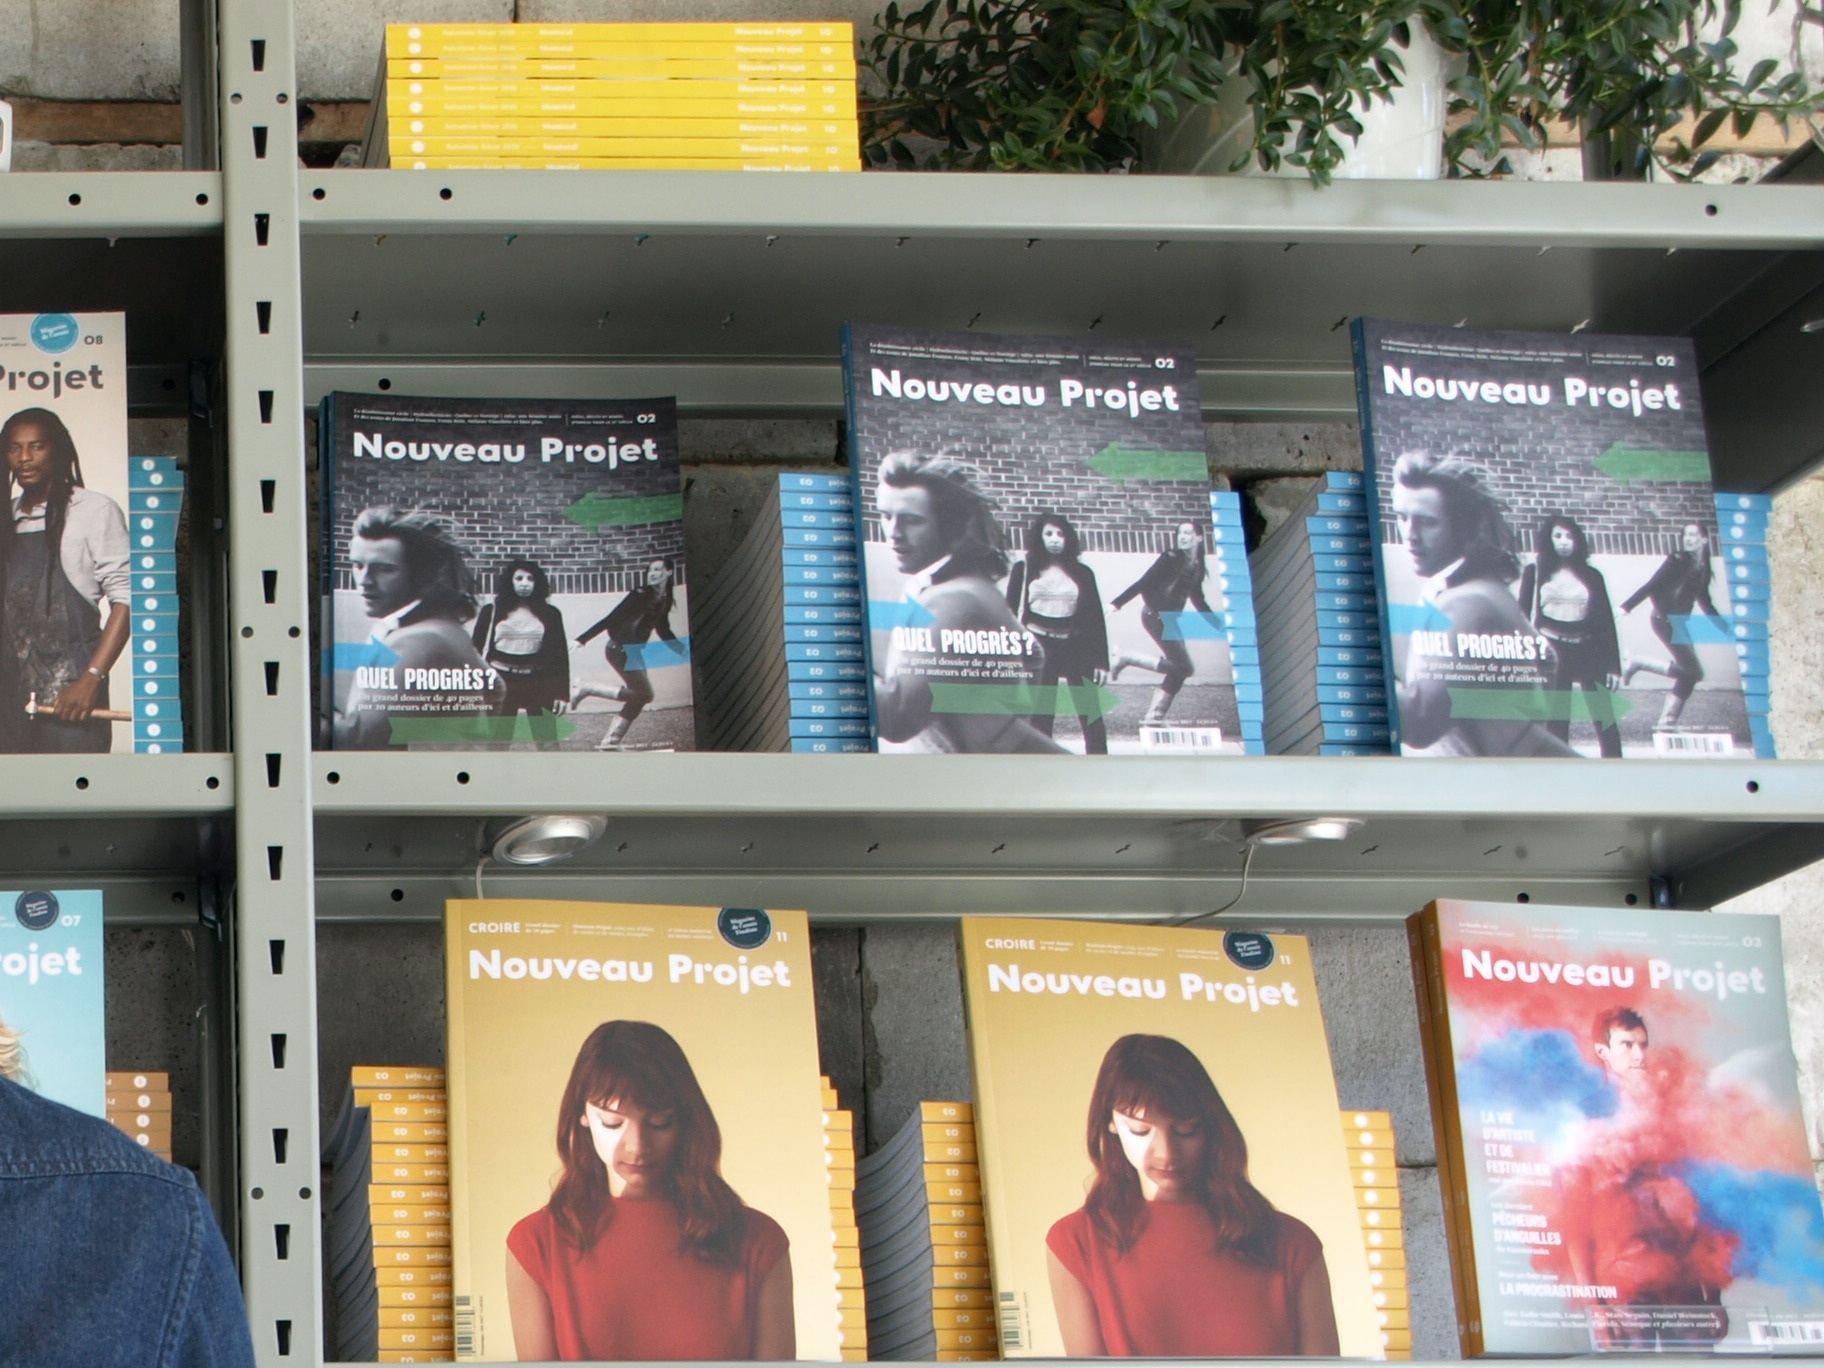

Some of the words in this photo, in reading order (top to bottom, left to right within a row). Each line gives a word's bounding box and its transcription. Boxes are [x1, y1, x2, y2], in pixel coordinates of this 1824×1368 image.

[83, 334, 104, 346] 08
[1154, 357, 1176, 370] 02
[1655, 355, 1676, 368] 02
[870, 367, 1046, 407] Nouveau
[1059, 378, 1180, 419] Projet
[1382, 364, 1552, 406] Nouveau
[1562, 376, 1681, 418] Projet
[636, 412, 656, 424] 02
[353, 431, 526, 462] Nouveau
[540, 435, 659, 470] Projet
[892, 625, 936, 653] QUEL
[1411, 629, 1454, 657] QUEL
[355, 666, 399, 690] QUEL
[61, 914, 82, 927] 07
[468, 922, 521, 934] CROIRE
[984, 937, 1036, 950] CROIRE
[1742, 935, 1762, 948] 03
[468, 949, 654, 982] Nouveau
[667, 953, 792, 995] Projet
[1460, 948, 1635, 988] Nouveau
[1647, 958, 1767, 1001] Projet
[987, 963, 1167, 1000] Nouveau
[1179, 972, 1299, 1012] Projet
[1480, 1110, 1495, 1124] LA
[1496, 1111, 1514, 1126] VIE
[1482, 1127, 1536, 1142] D'ARTISTE
[1484, 1144, 1498, 1157] ET
[1499, 1144, 1514, 1158] DE
[1486, 1160, 1552, 1177] FESTIVALIER
[1492, 1210, 1547, 1228] PÊCHEURS
[1494, 1229, 1562, 1246] D'ANGUILLES
[1499, 1282, 1514, 1297] LA
[1515, 1283, 1617, 1299] PROCRASTINATION
